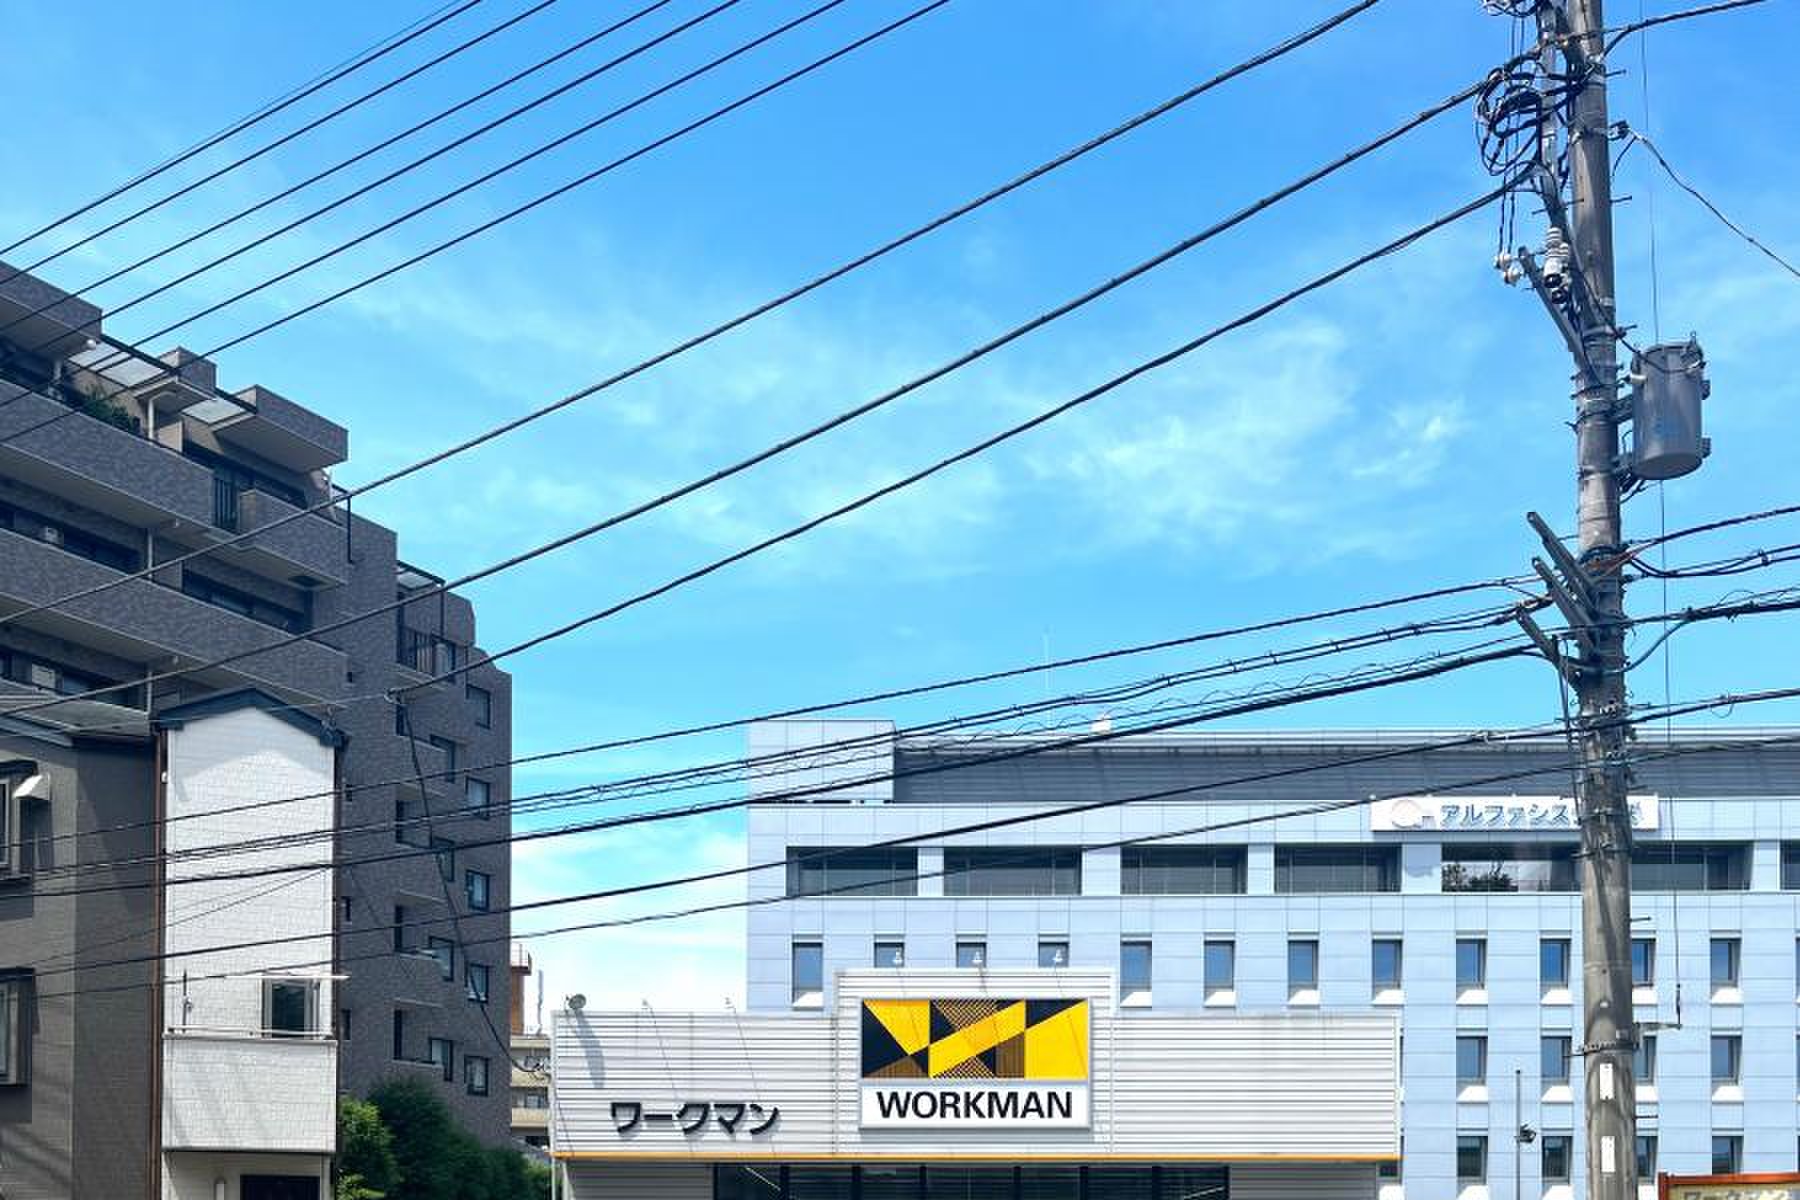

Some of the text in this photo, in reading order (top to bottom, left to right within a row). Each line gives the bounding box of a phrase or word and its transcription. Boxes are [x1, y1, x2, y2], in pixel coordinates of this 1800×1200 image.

[611, 1102, 779, 1135] ワークマン
[876, 1091, 1073, 1119] WORKMAN
